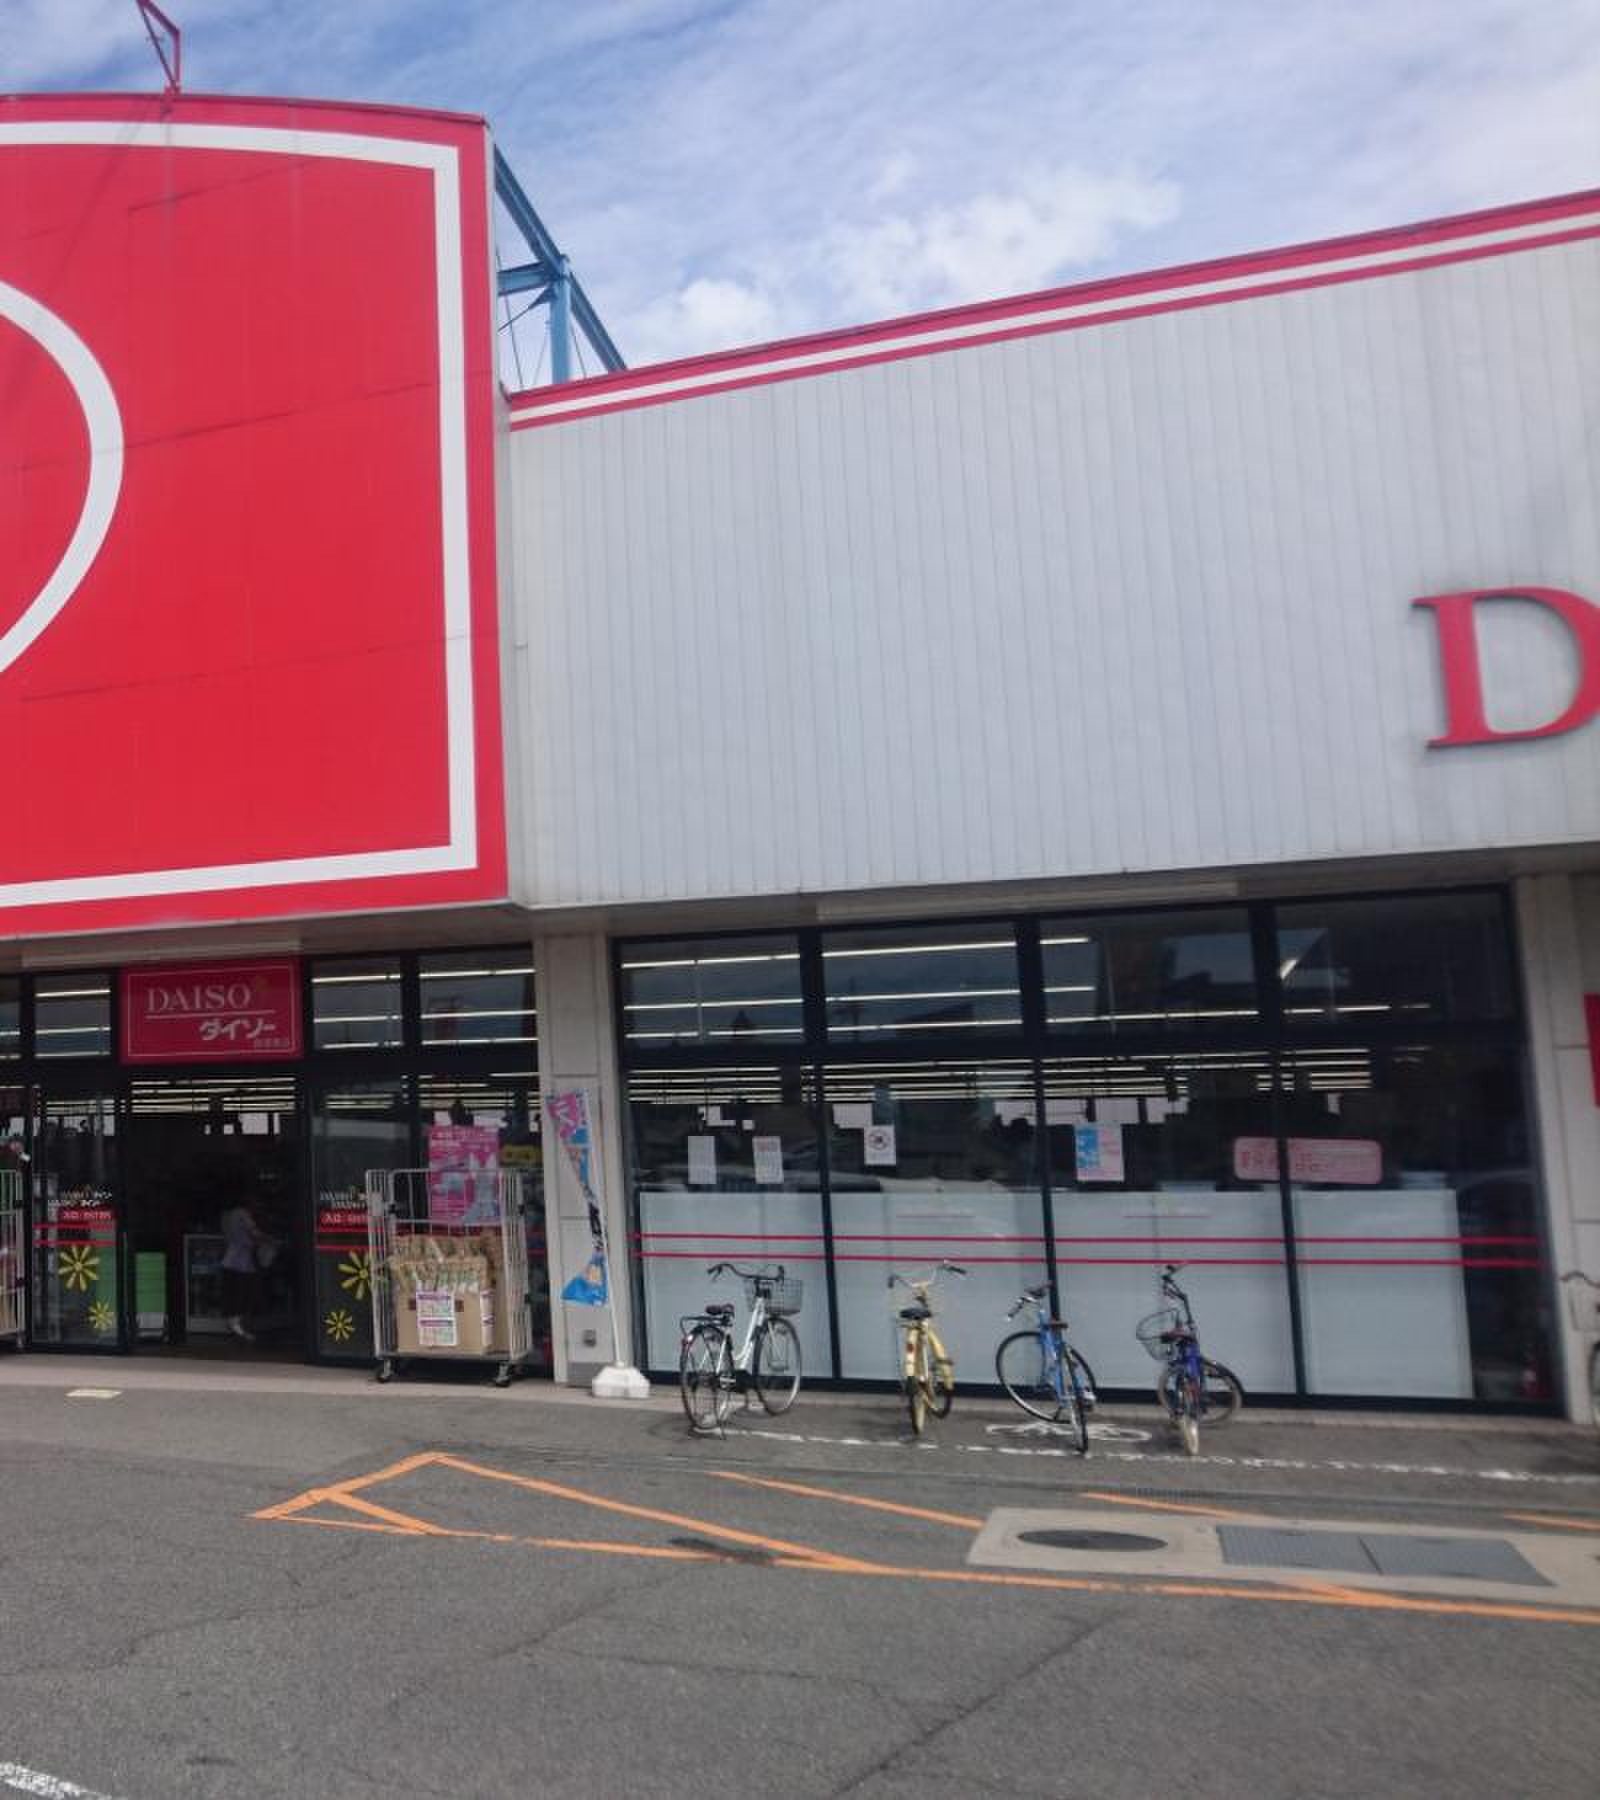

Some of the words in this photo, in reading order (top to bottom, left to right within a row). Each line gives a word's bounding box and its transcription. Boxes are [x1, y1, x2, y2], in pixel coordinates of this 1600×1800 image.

[1409, 586, 1600, 750] D
[146, 983, 251, 1013] DAISO
[200, 1017, 276, 1041] ダイソー
